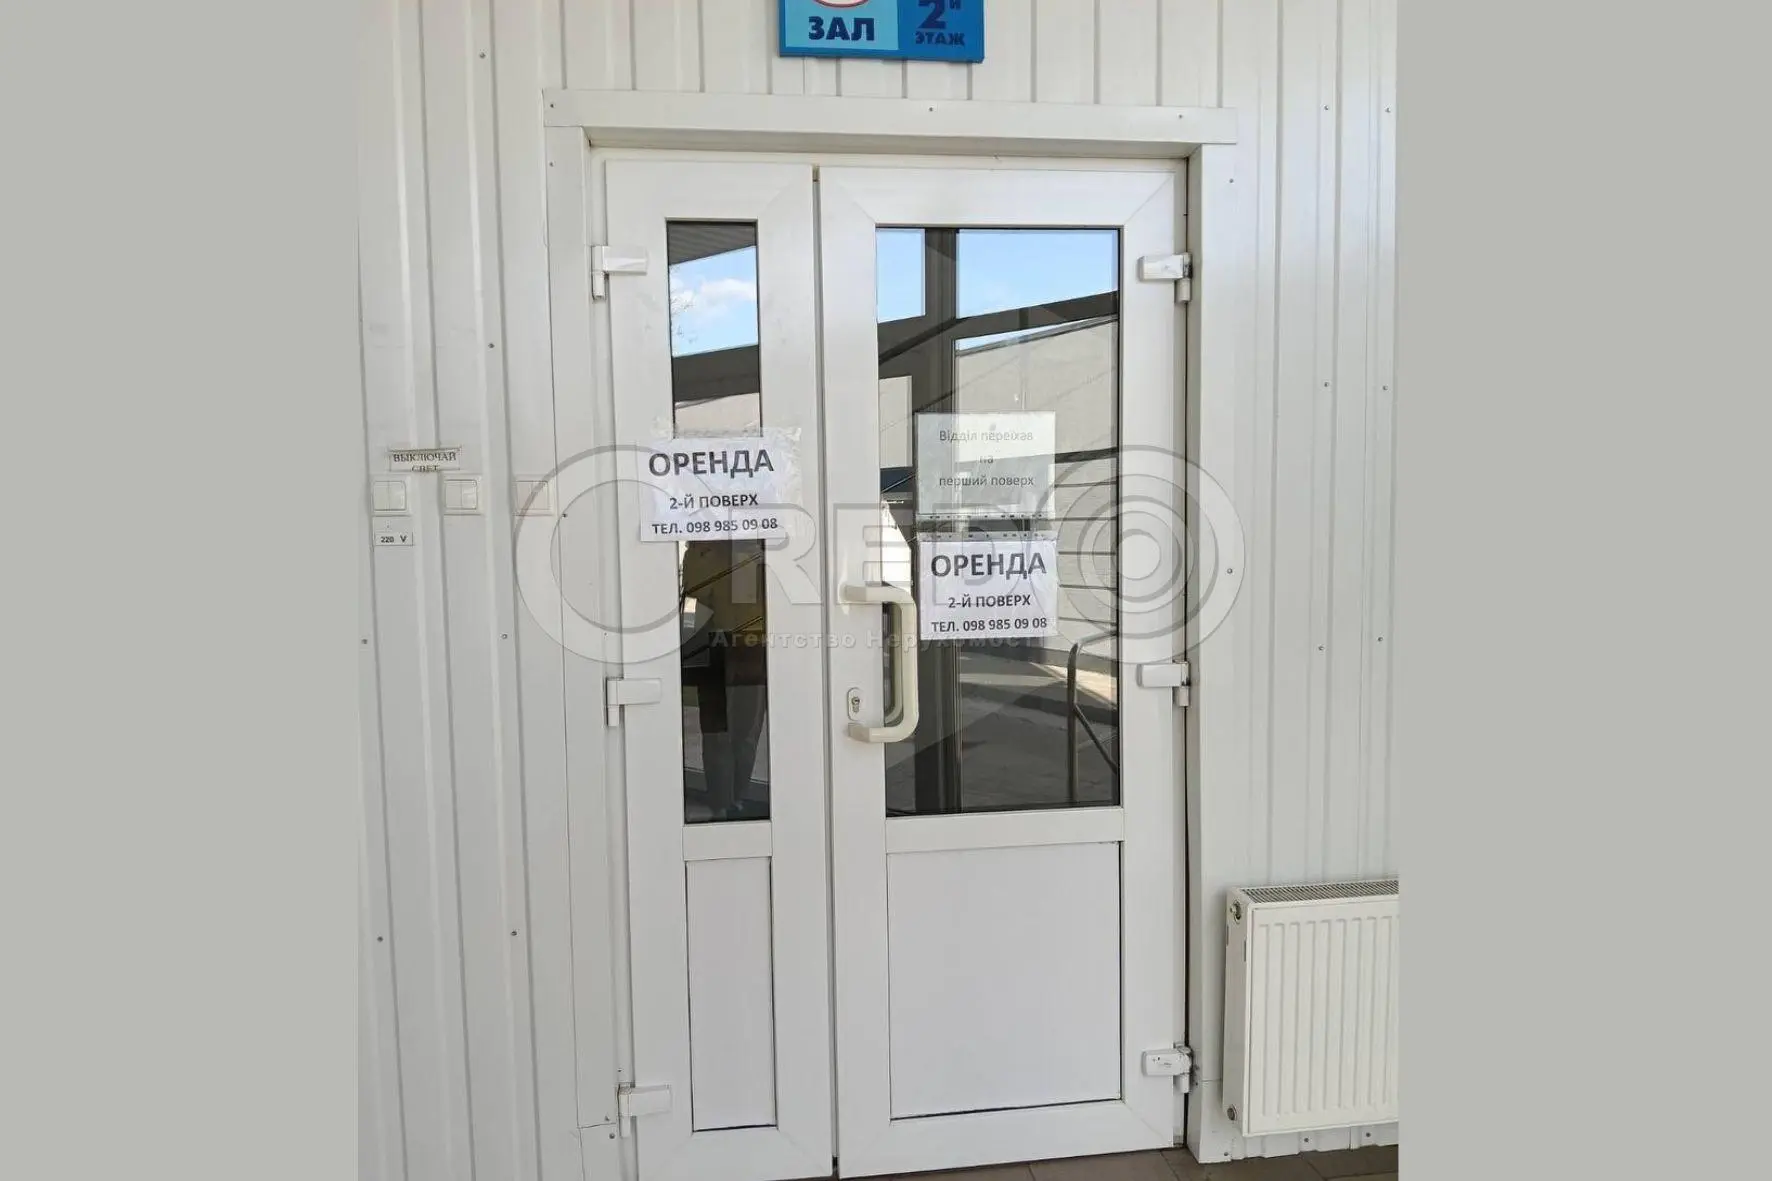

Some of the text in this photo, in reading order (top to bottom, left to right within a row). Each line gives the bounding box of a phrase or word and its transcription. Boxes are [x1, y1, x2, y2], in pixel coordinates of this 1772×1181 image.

[808, 16, 875, 41] ЗАЛ
[915, 32, 965, 46] ЭТАЖ
[939, 430, 977, 444] Відділ
[393, 451, 457, 463] ВЫКЛЮЧАЙ
[649, 449, 774, 479] ОРЕНДА
[939, 474, 1035, 488] перший поверх
[669, 494, 759, 510] 2-Й ПОВЕРХ
[652, 518, 778, 534] ТЕЛ. 098 985 09 08
[400, 535, 407, 543] V
[931, 552, 1047, 580] ОРЕНДА
[948, 594, 1031, 608] 2-Й ПОВЕРХ
[931, 617, 1047, 633] ТЕЛ. 098 985 09 08
